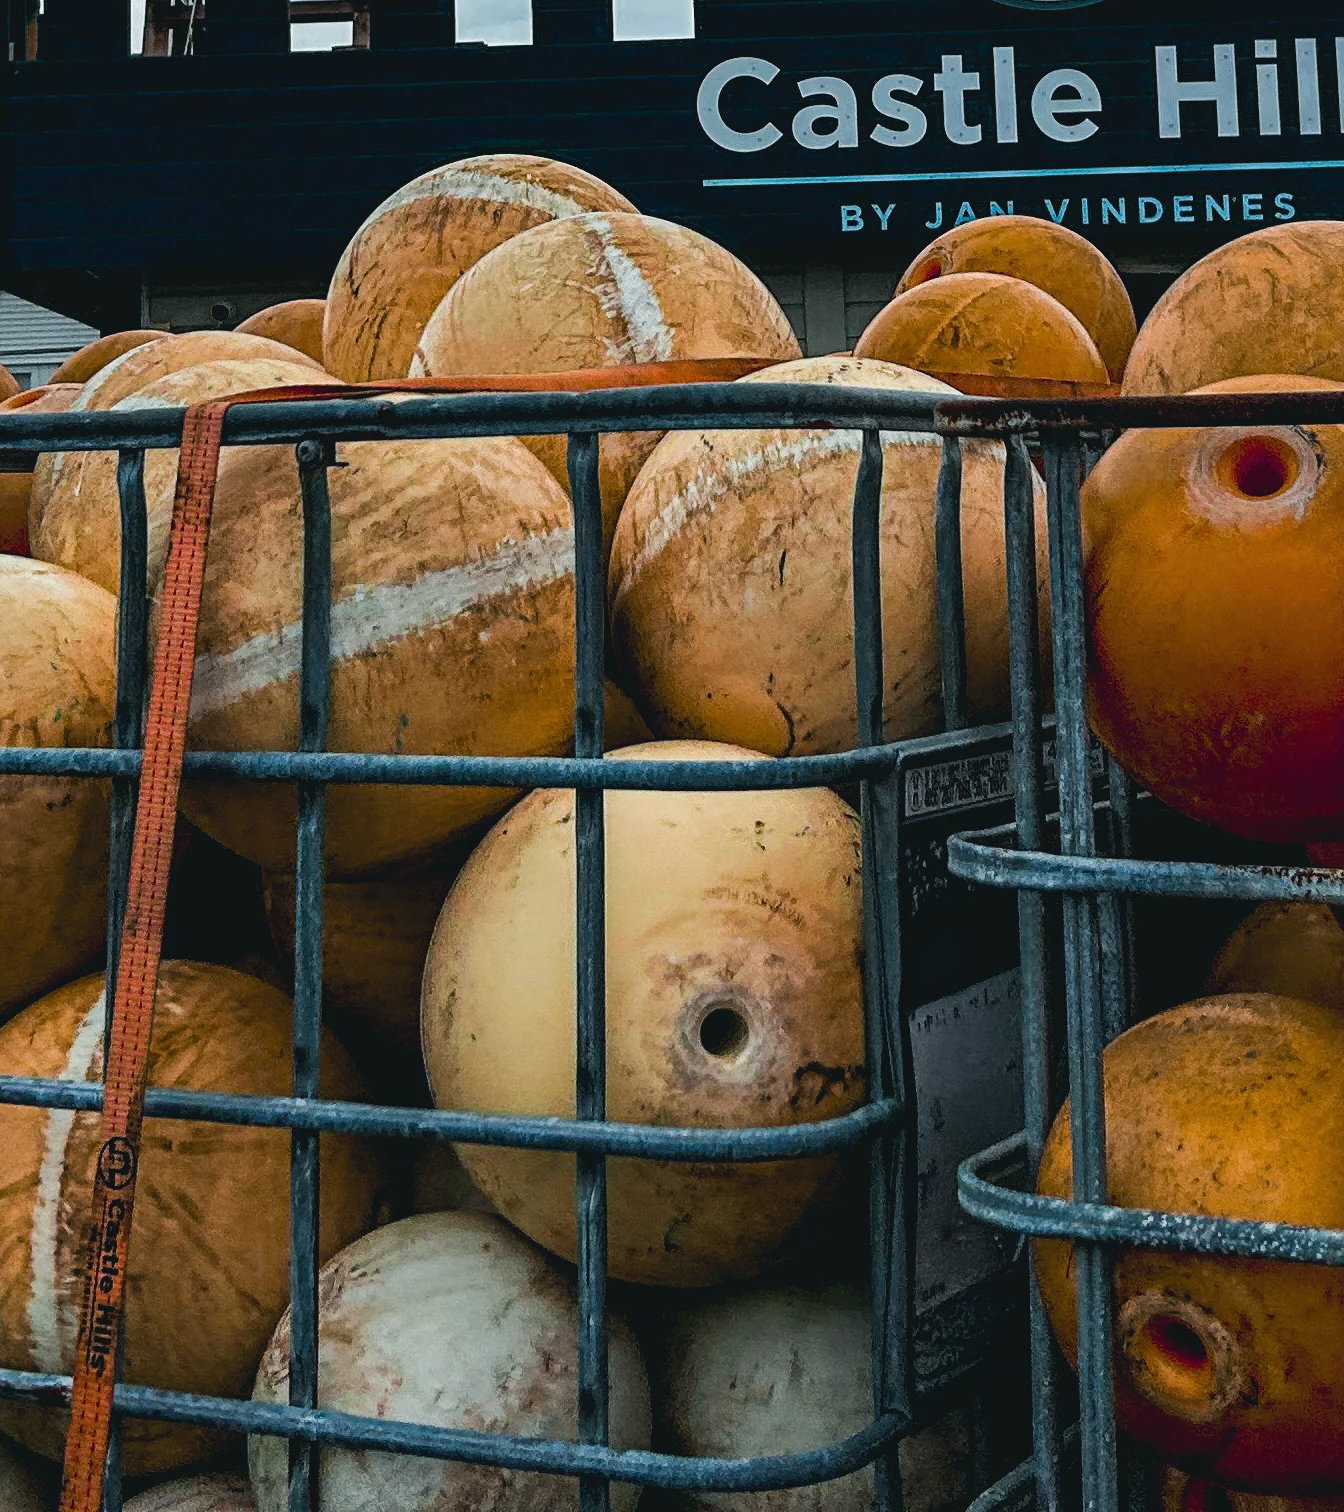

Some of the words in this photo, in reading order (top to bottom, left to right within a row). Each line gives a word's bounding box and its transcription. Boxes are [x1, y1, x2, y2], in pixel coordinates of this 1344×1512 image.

[697, 46, 1102, 153] Castle
[841, 203, 896, 232] BY
[1044, 193, 1296, 225] VINDENES
[99, 1198, 126, 1295] Castle
[90, 1303, 116, 1369] Hills
